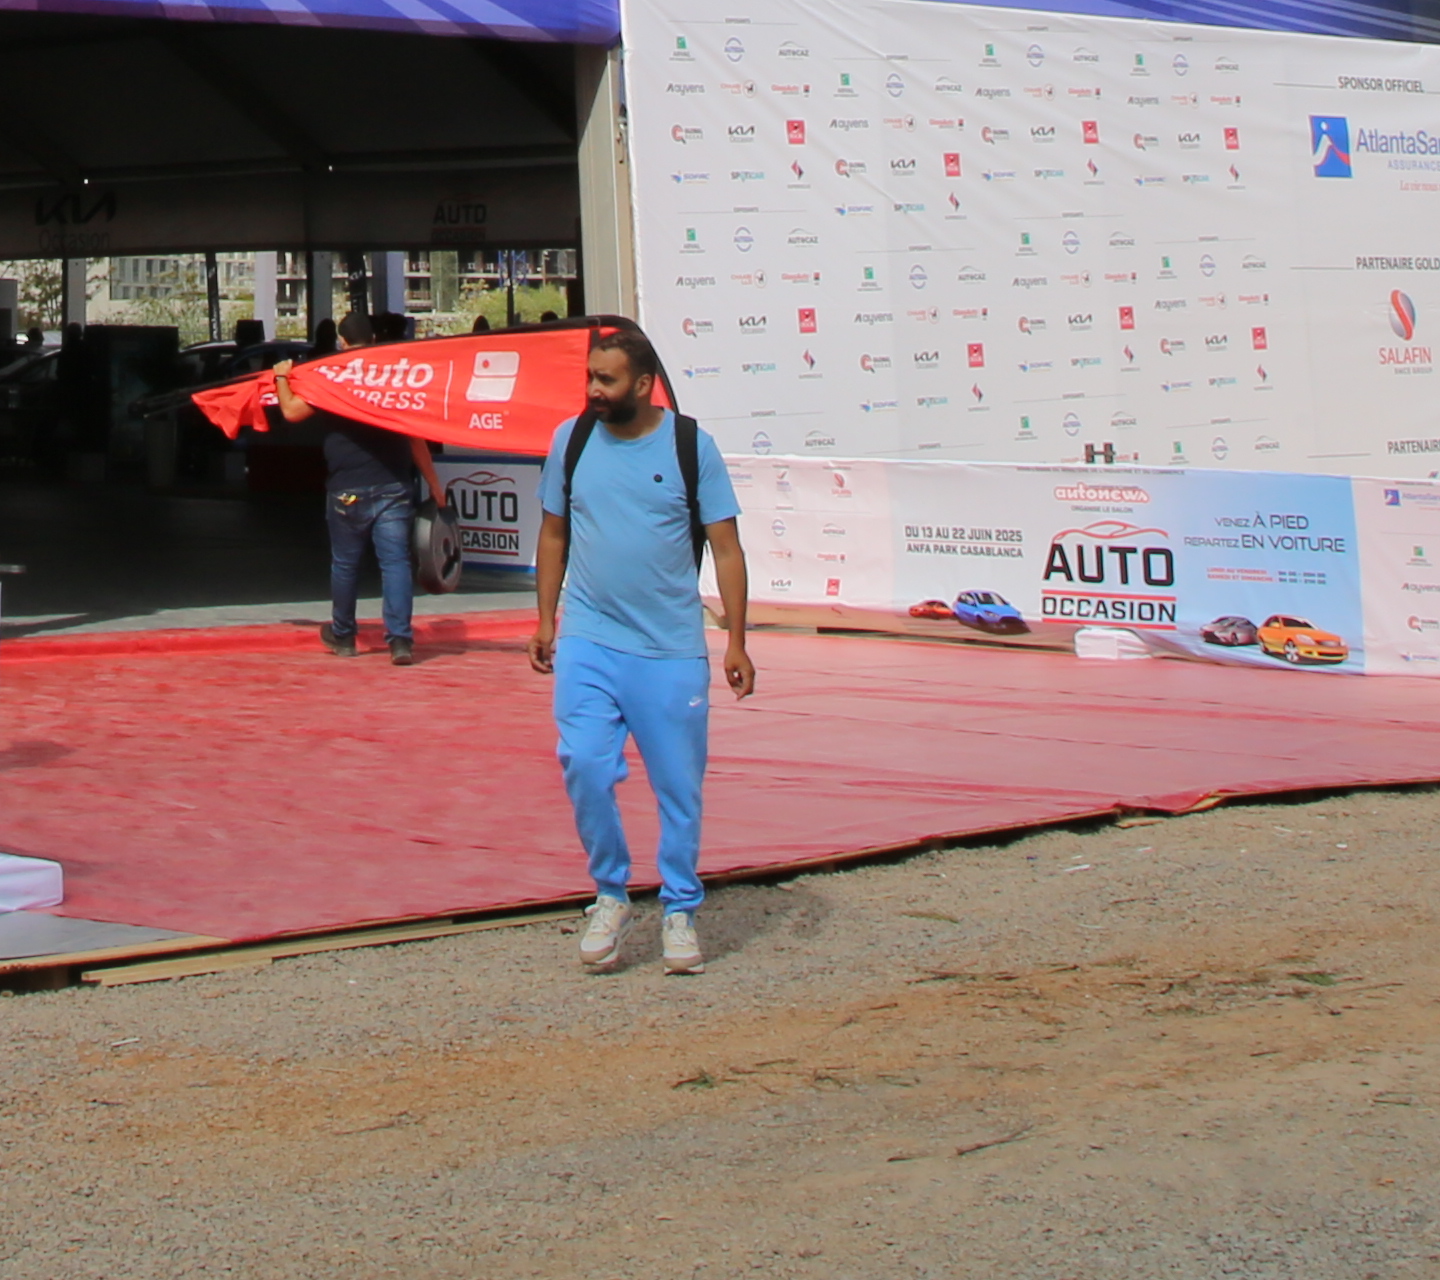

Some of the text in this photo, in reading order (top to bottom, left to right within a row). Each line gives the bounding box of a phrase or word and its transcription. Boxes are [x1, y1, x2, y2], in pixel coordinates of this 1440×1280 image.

[1338, 76, 1424, 93] SPONSOR OFFICIEL
[1356, 257, 1440, 270] PARTENAIRE GOLD
[1379, 347, 1432, 364] SALAFIN
[469, 414, 503, 430] AGE
[445, 488, 519, 523] AUTO
[1215, 511, 1309, 529] VENEZ À PIED
[462, 531, 519, 550] CASION
[905, 526, 1023, 541] DU 13 AU 22 JUIN 2025
[906, 543, 1023, 558] ANFA PARK CASABLANCA
[1184, 534, 1346, 552] REPARTEZ EN VOITURE
[1042, 542, 1174, 586] AUTO
[1042, 596, 1176, 623] OCCASION
